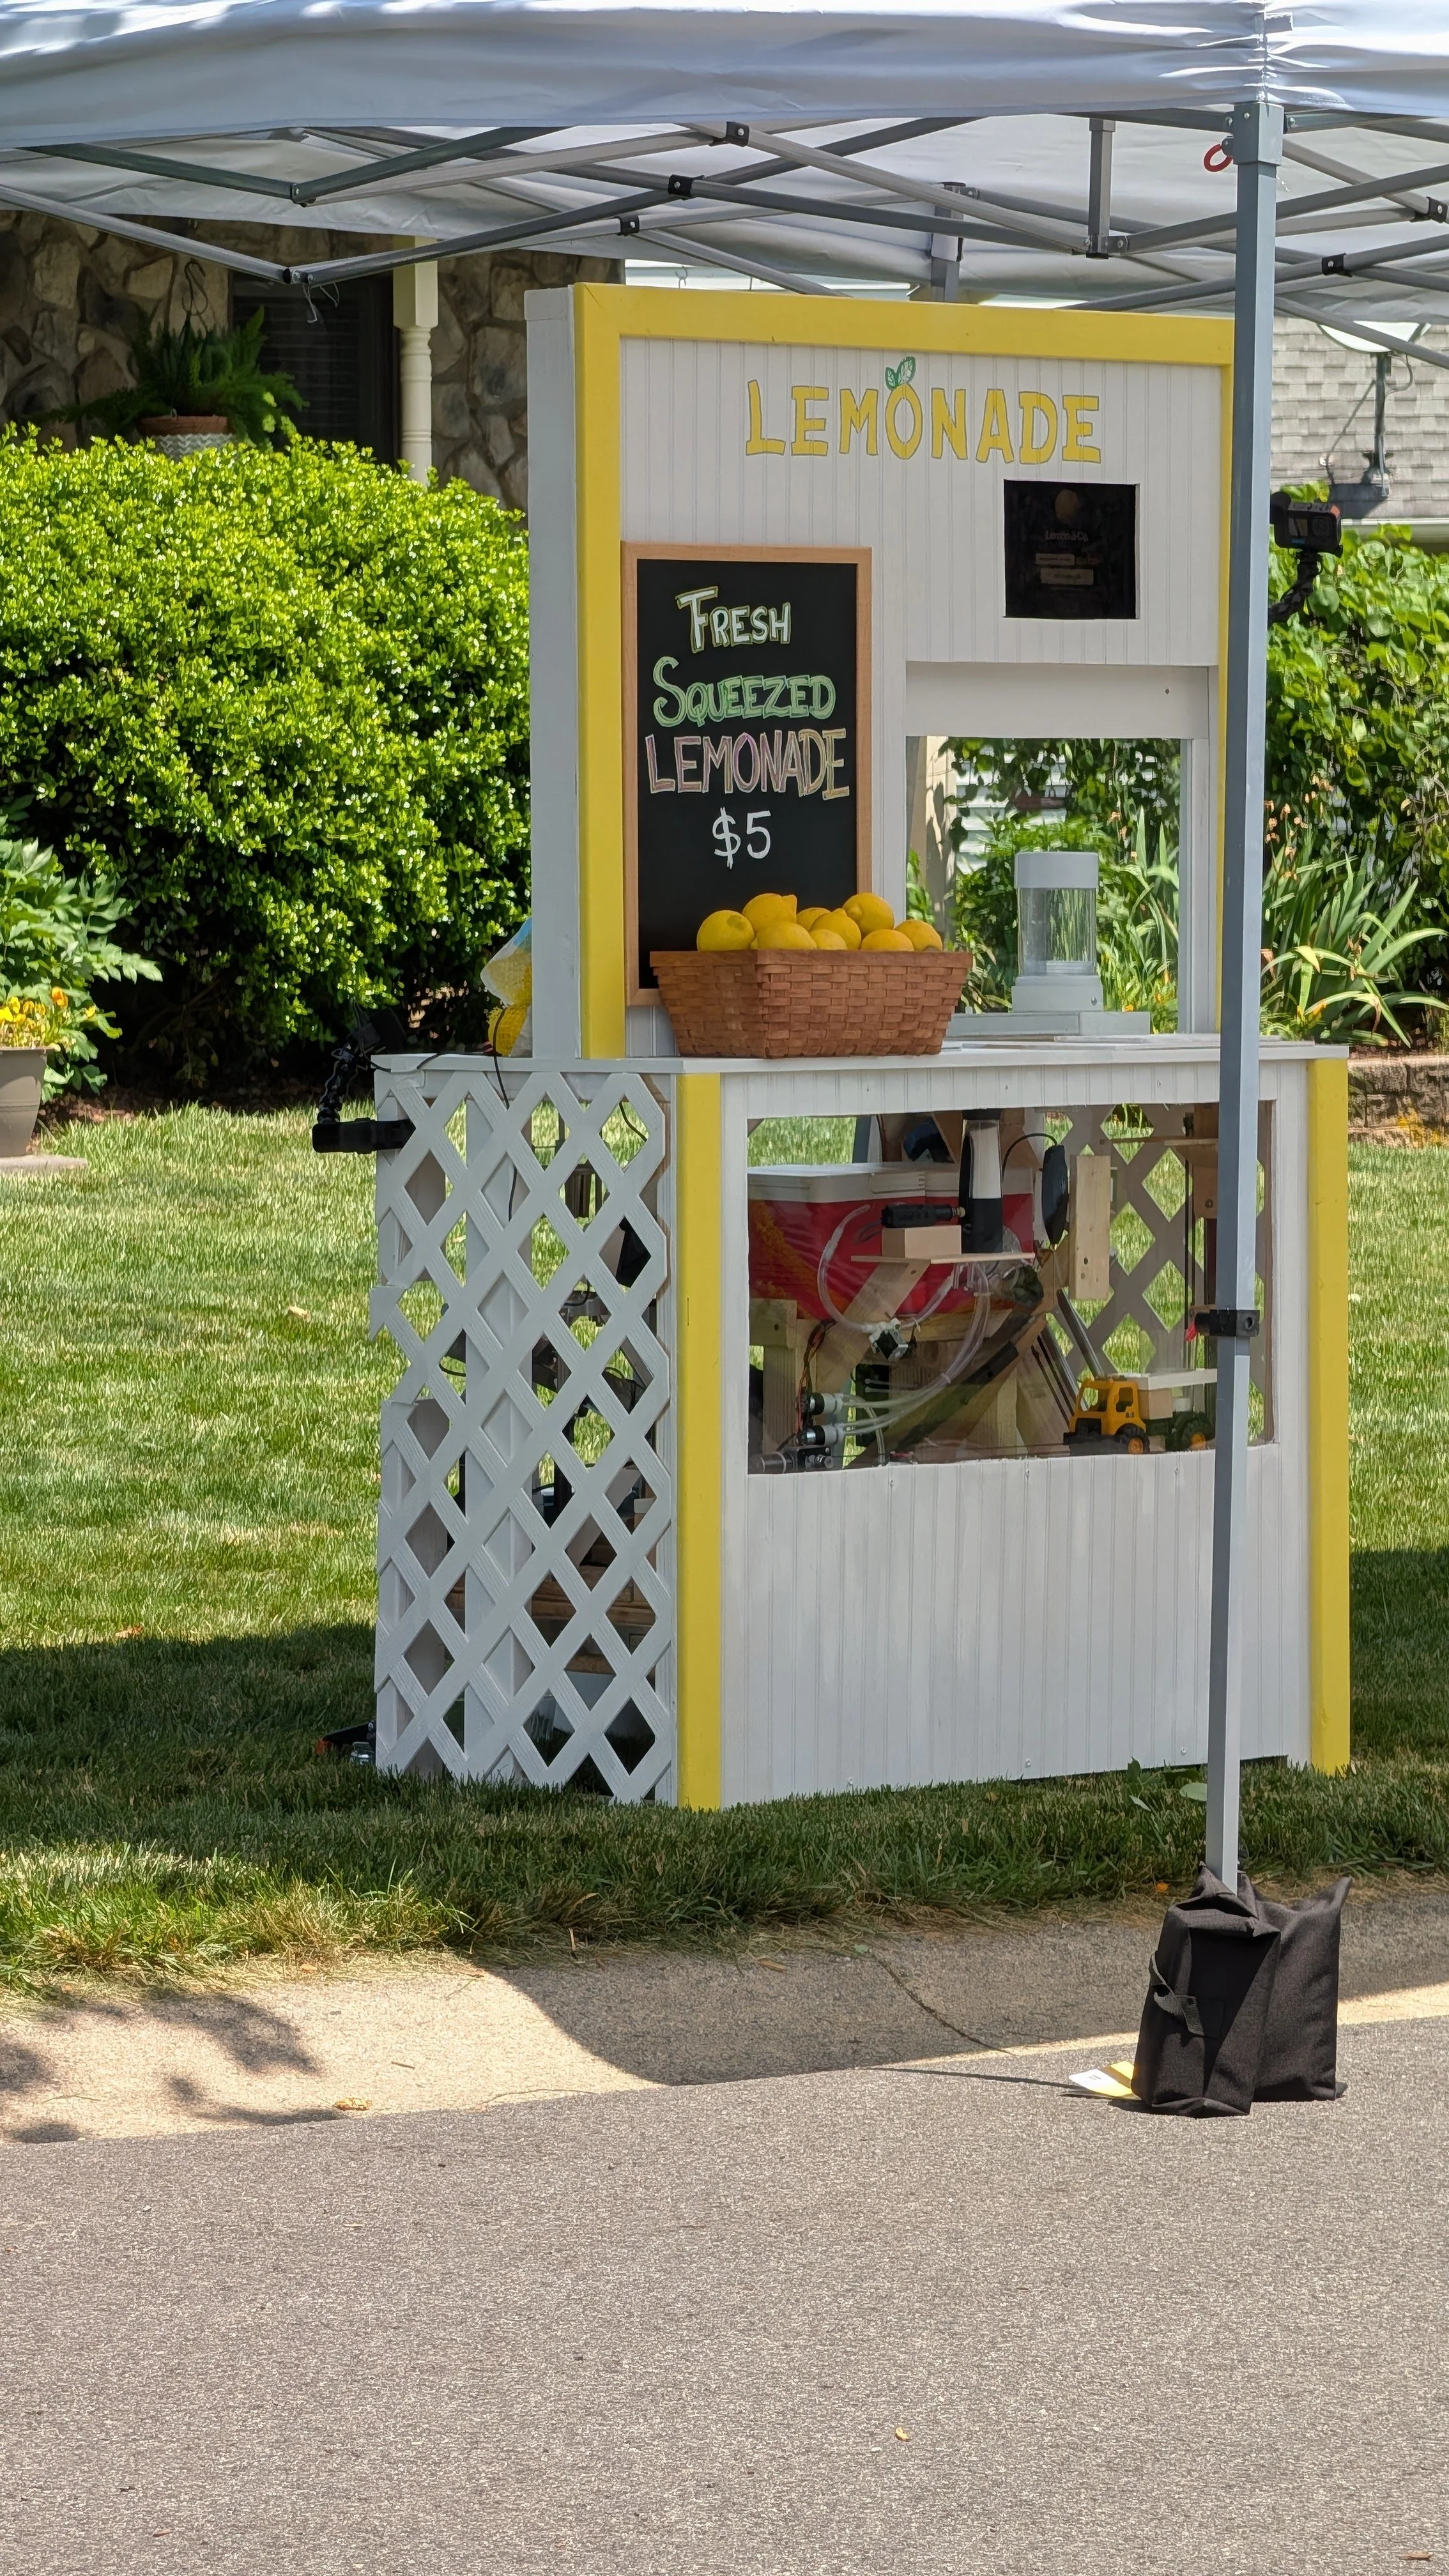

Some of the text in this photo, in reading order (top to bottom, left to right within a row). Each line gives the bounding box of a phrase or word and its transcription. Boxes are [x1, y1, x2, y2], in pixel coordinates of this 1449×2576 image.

[746, 379, 1101, 465] LEMONADE
[675, 585, 792, 654] FRESH
[653, 656, 836, 727] SQUEEZED
[645, 728, 850, 801] LEMONADE
[712, 807, 772, 870] $5
